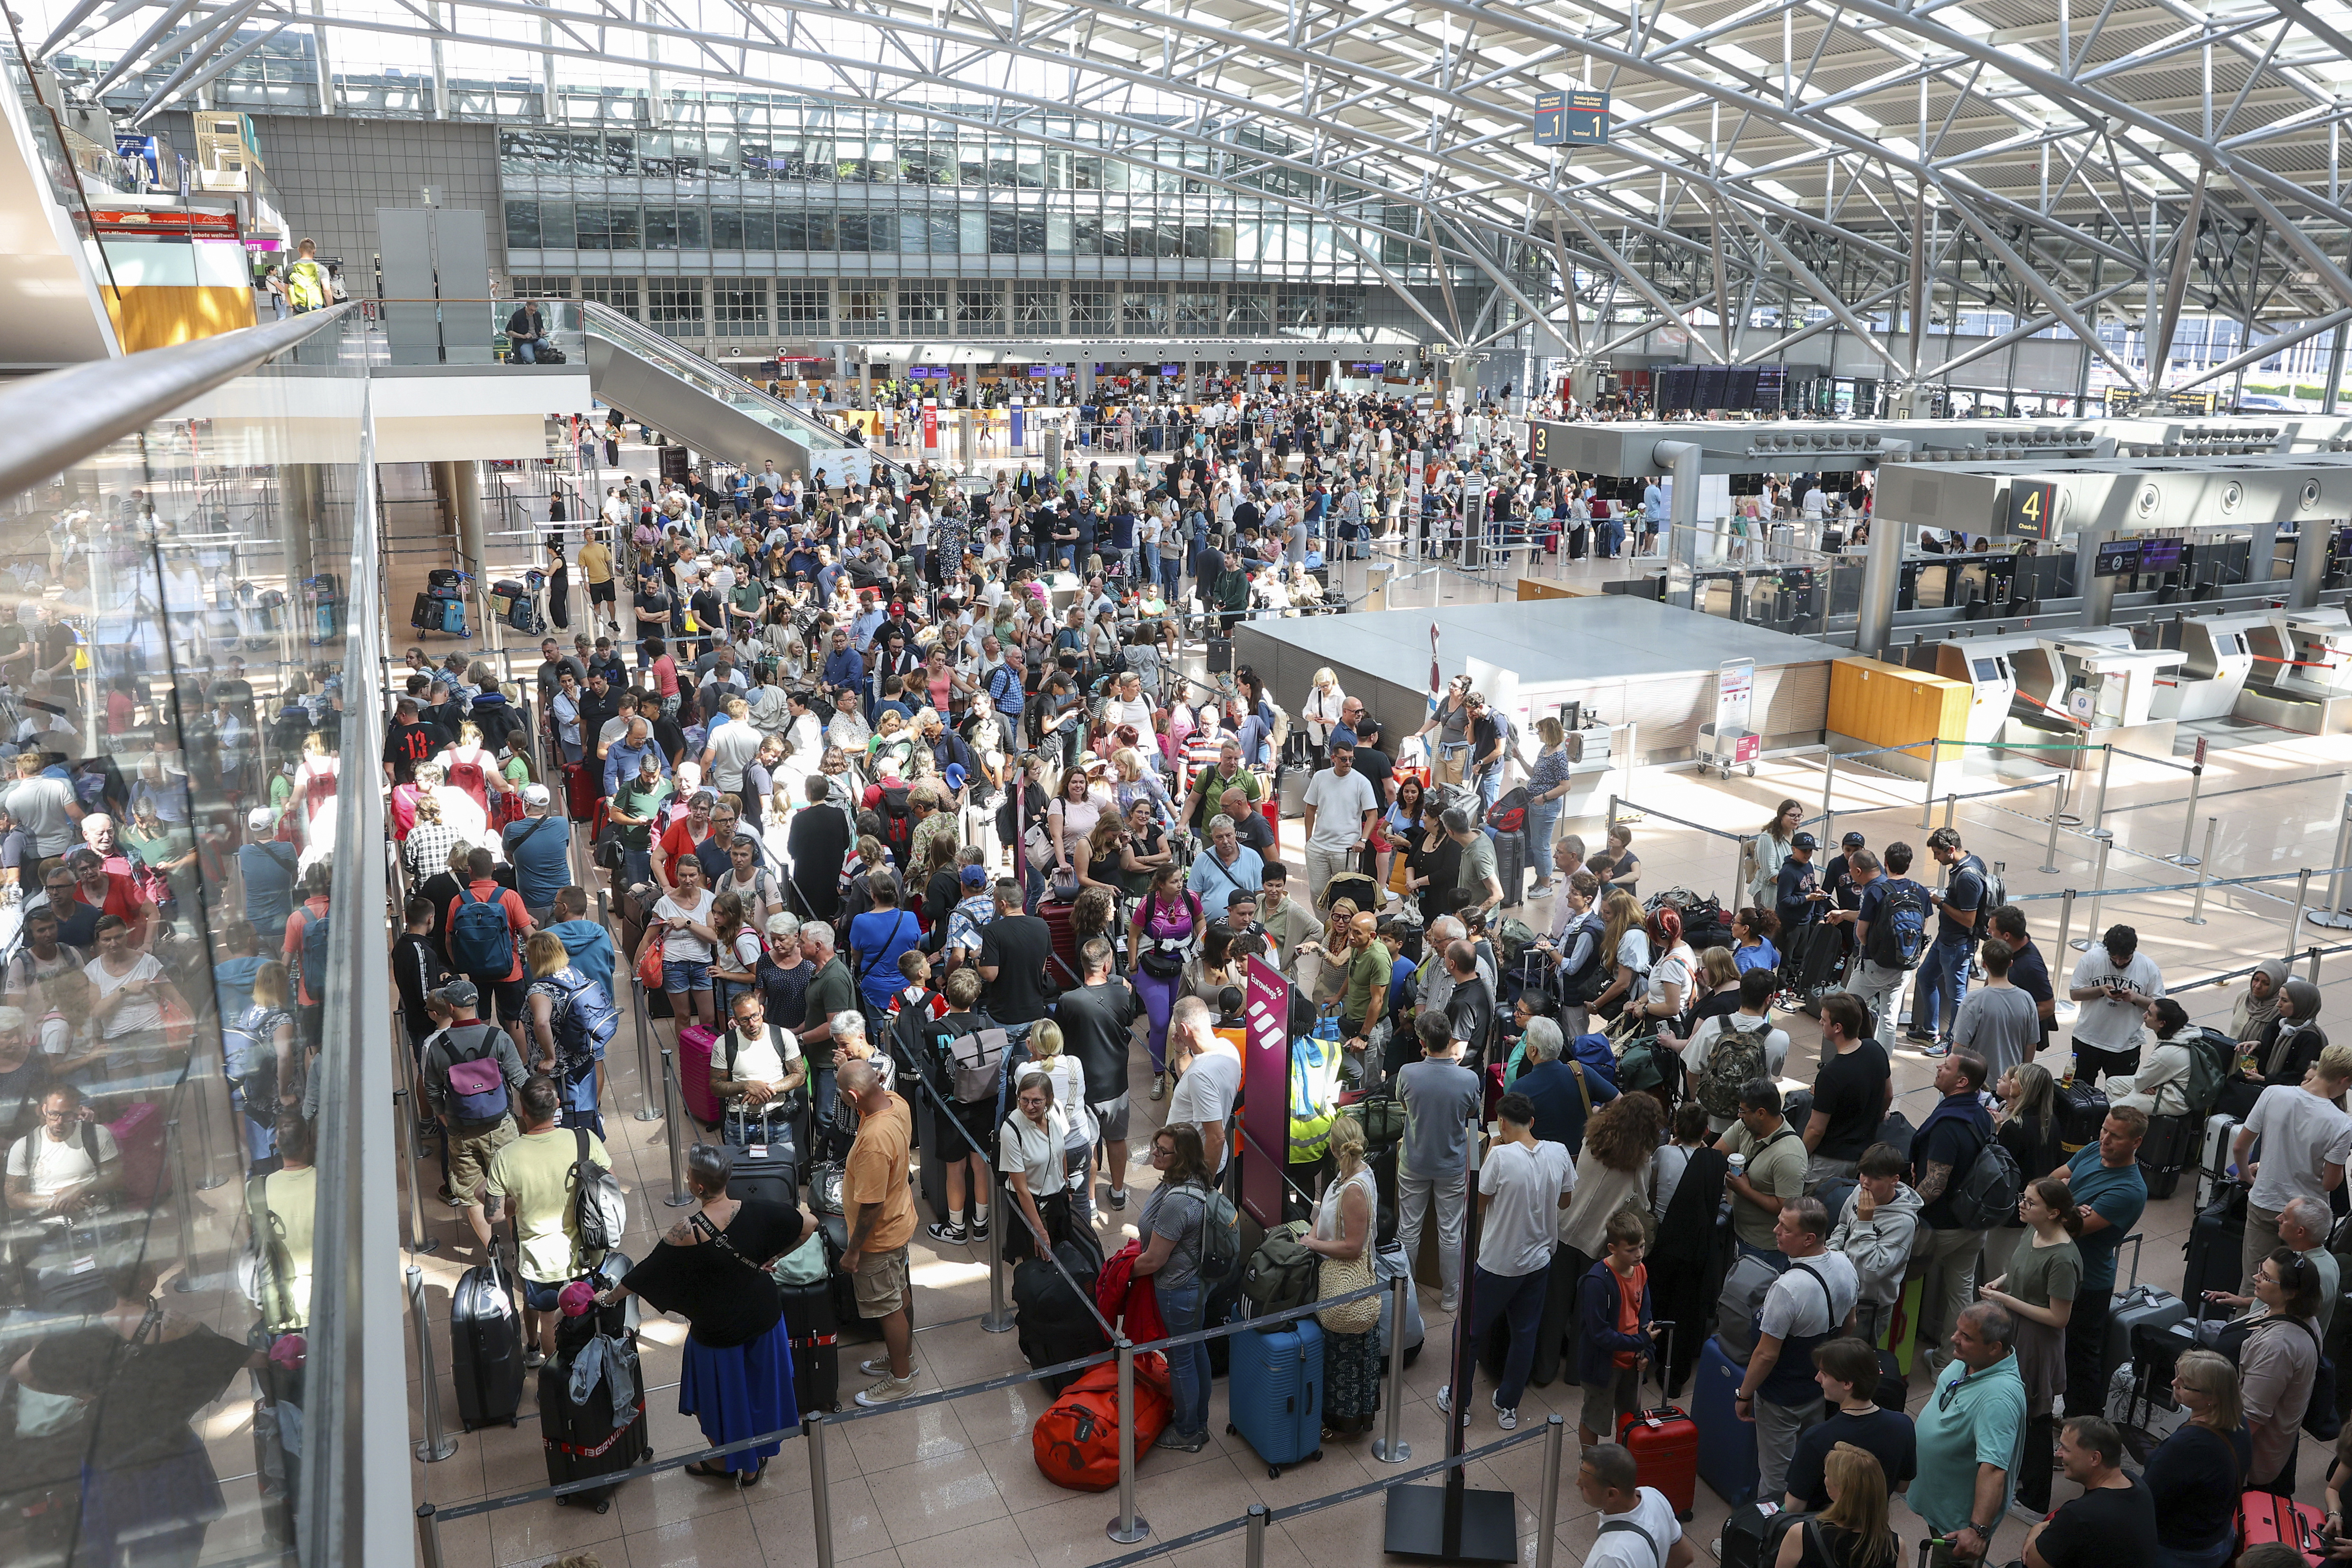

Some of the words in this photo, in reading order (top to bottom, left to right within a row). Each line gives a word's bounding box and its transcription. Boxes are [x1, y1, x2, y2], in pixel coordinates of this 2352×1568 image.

[1553, 115, 1559, 136] 1
[1592, 116, 1600, 137] 1
[1420, 347, 1424, 356] 2
[1536, 428, 1546, 450] 3
[2022, 491, 2040, 521] 4
[2018, 523, 2038, 531] Check-in
[2114, 558, 2120, 568] 2
[404, 730, 428, 760] 13
[1251, 972, 1276, 1000] Eurowings
[898, 1072, 921, 1081] PUMA
